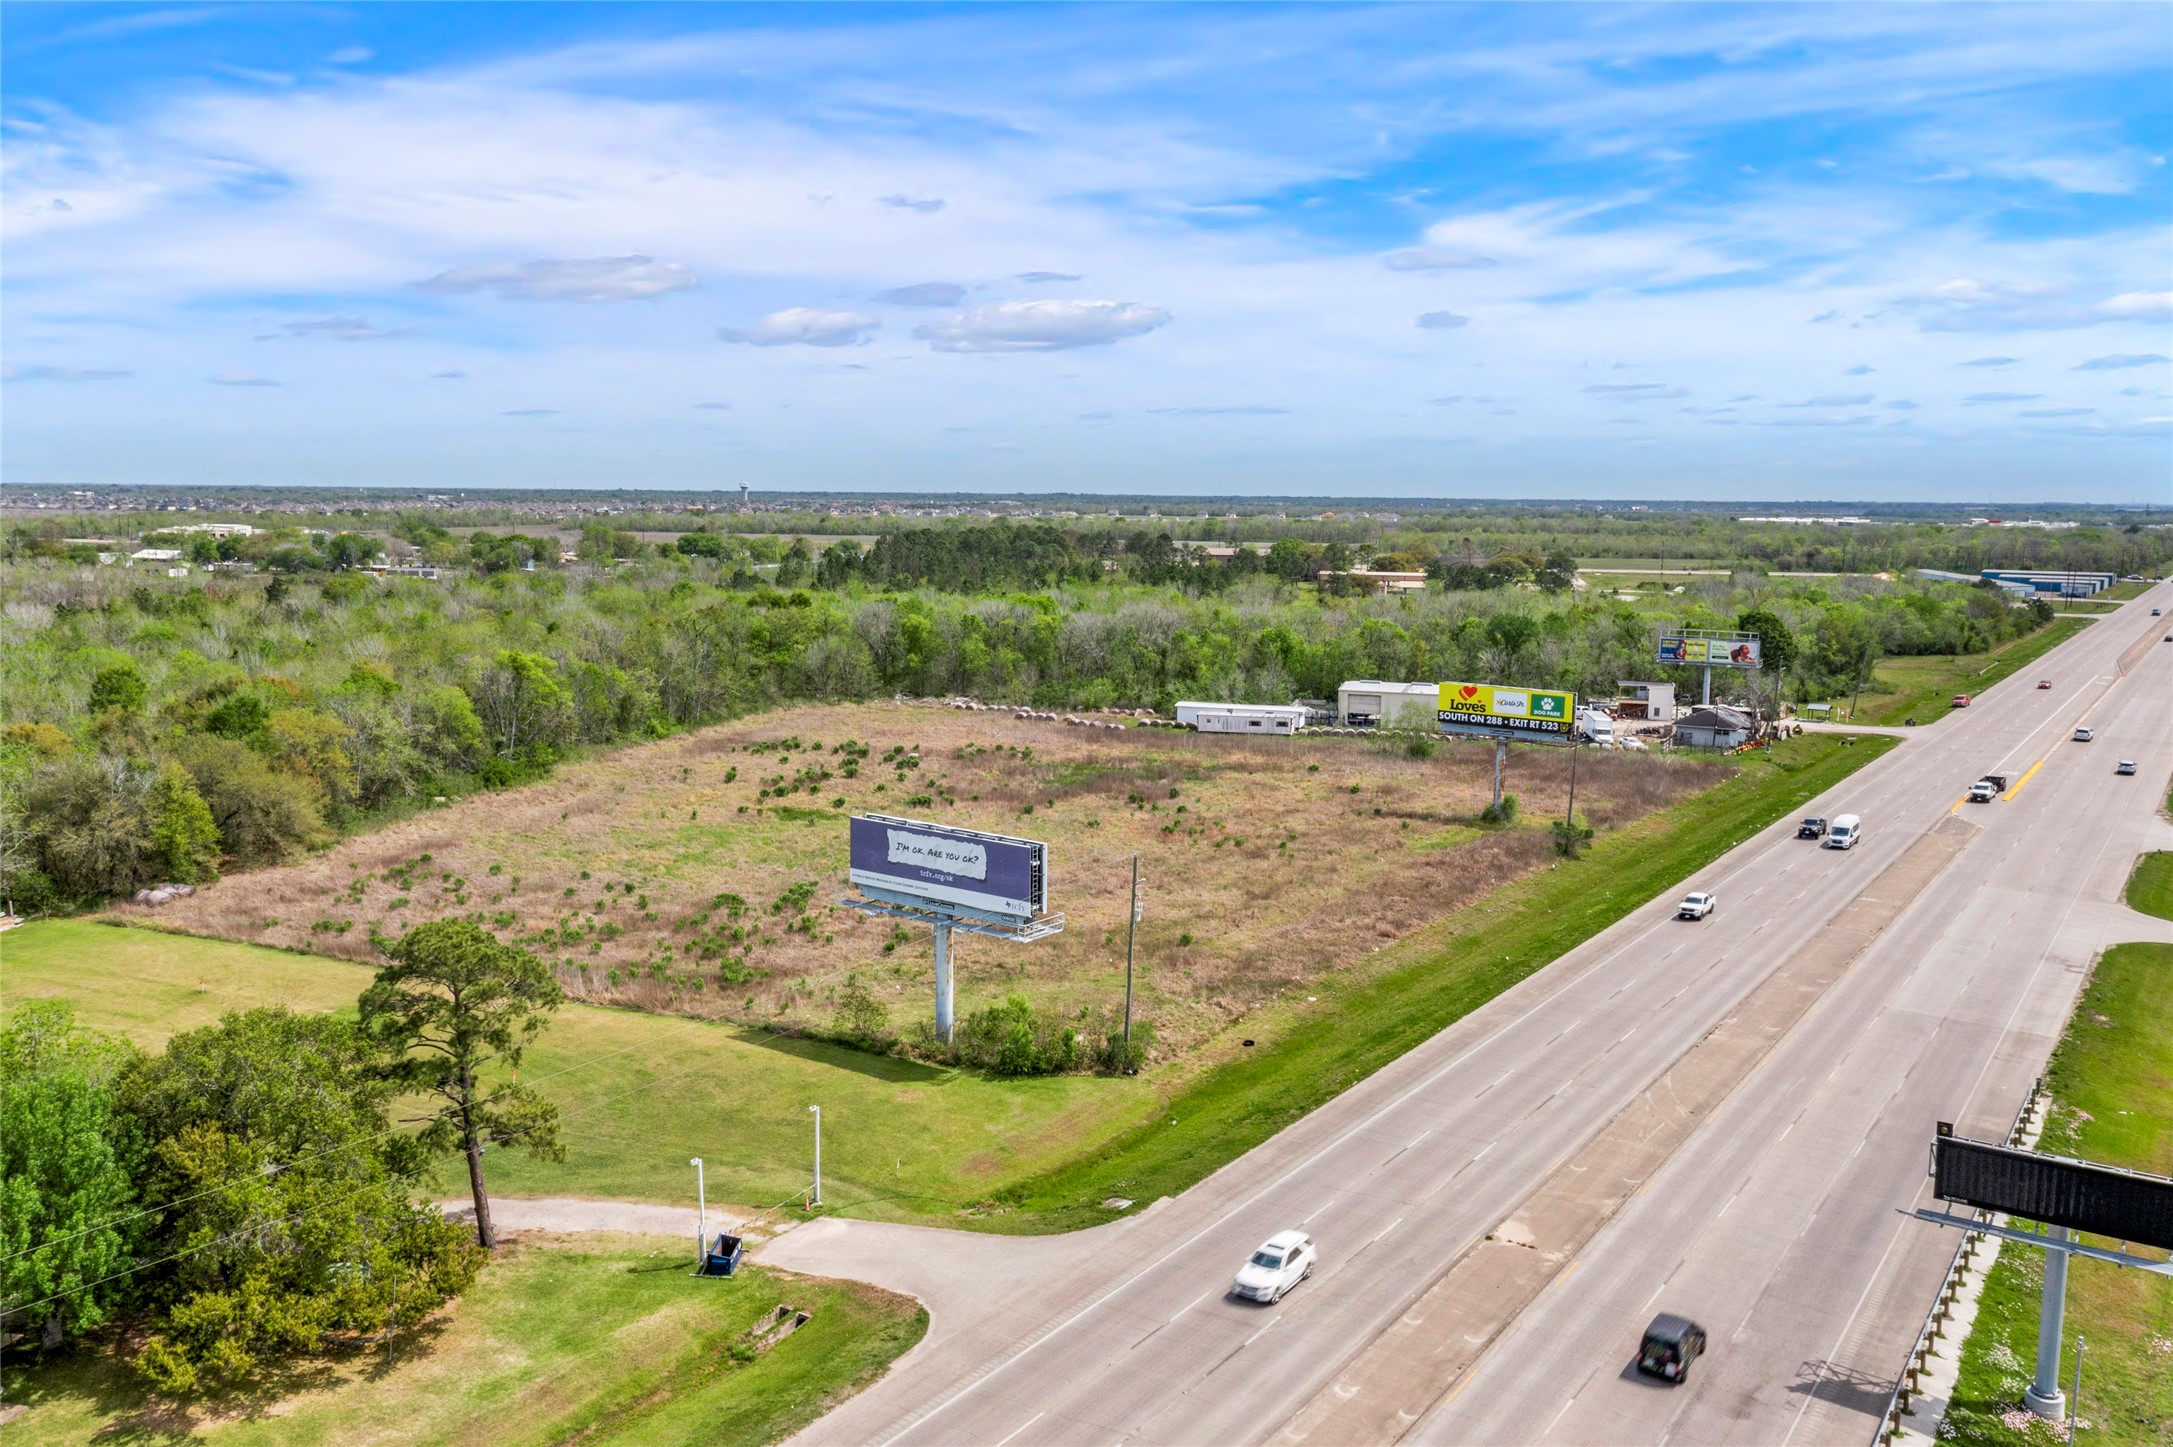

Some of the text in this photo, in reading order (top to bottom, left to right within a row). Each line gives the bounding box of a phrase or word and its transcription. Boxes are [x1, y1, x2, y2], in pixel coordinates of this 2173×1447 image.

[1439, 711, 1559, 731] SOUTH ON 288 EXIT RT 523
[896, 842, 909, 852] I'M
[927, 848, 943, 858] ARE
[945, 852, 960, 861] YOU
[962, 855, 979, 865] OK?
